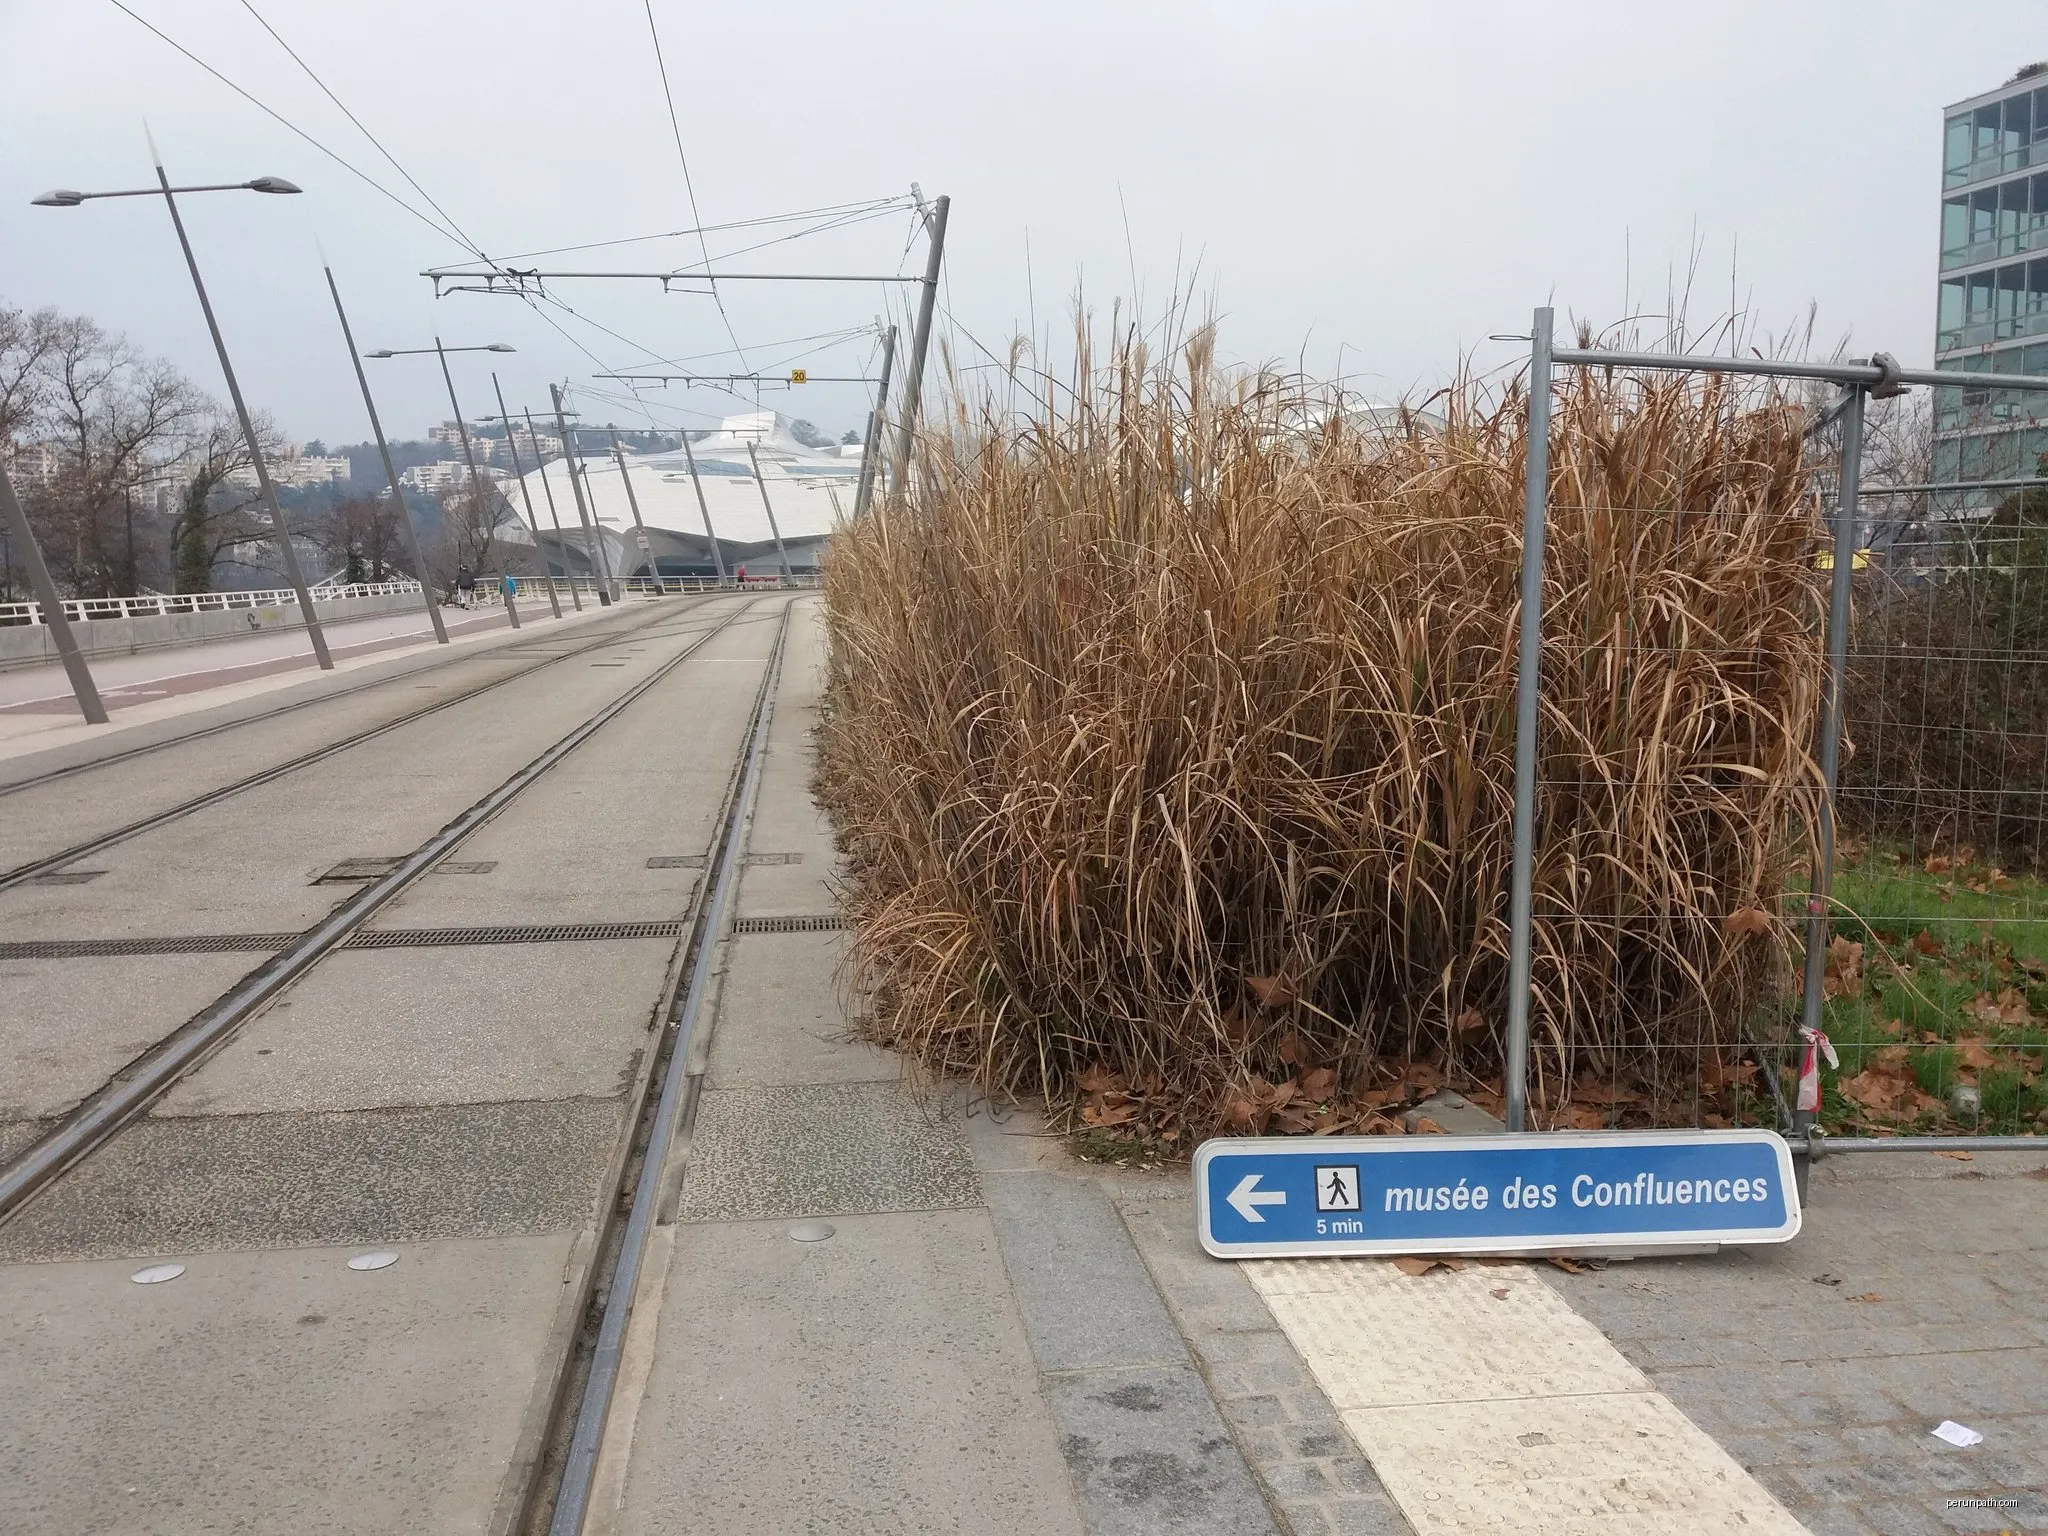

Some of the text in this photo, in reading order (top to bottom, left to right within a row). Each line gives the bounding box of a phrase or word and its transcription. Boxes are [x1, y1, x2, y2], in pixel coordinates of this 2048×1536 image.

[793, 371, 805, 381] 20
[1384, 1172, 1768, 1212] musée des Confluences
[1316, 1218, 1364, 1235] 5 min
